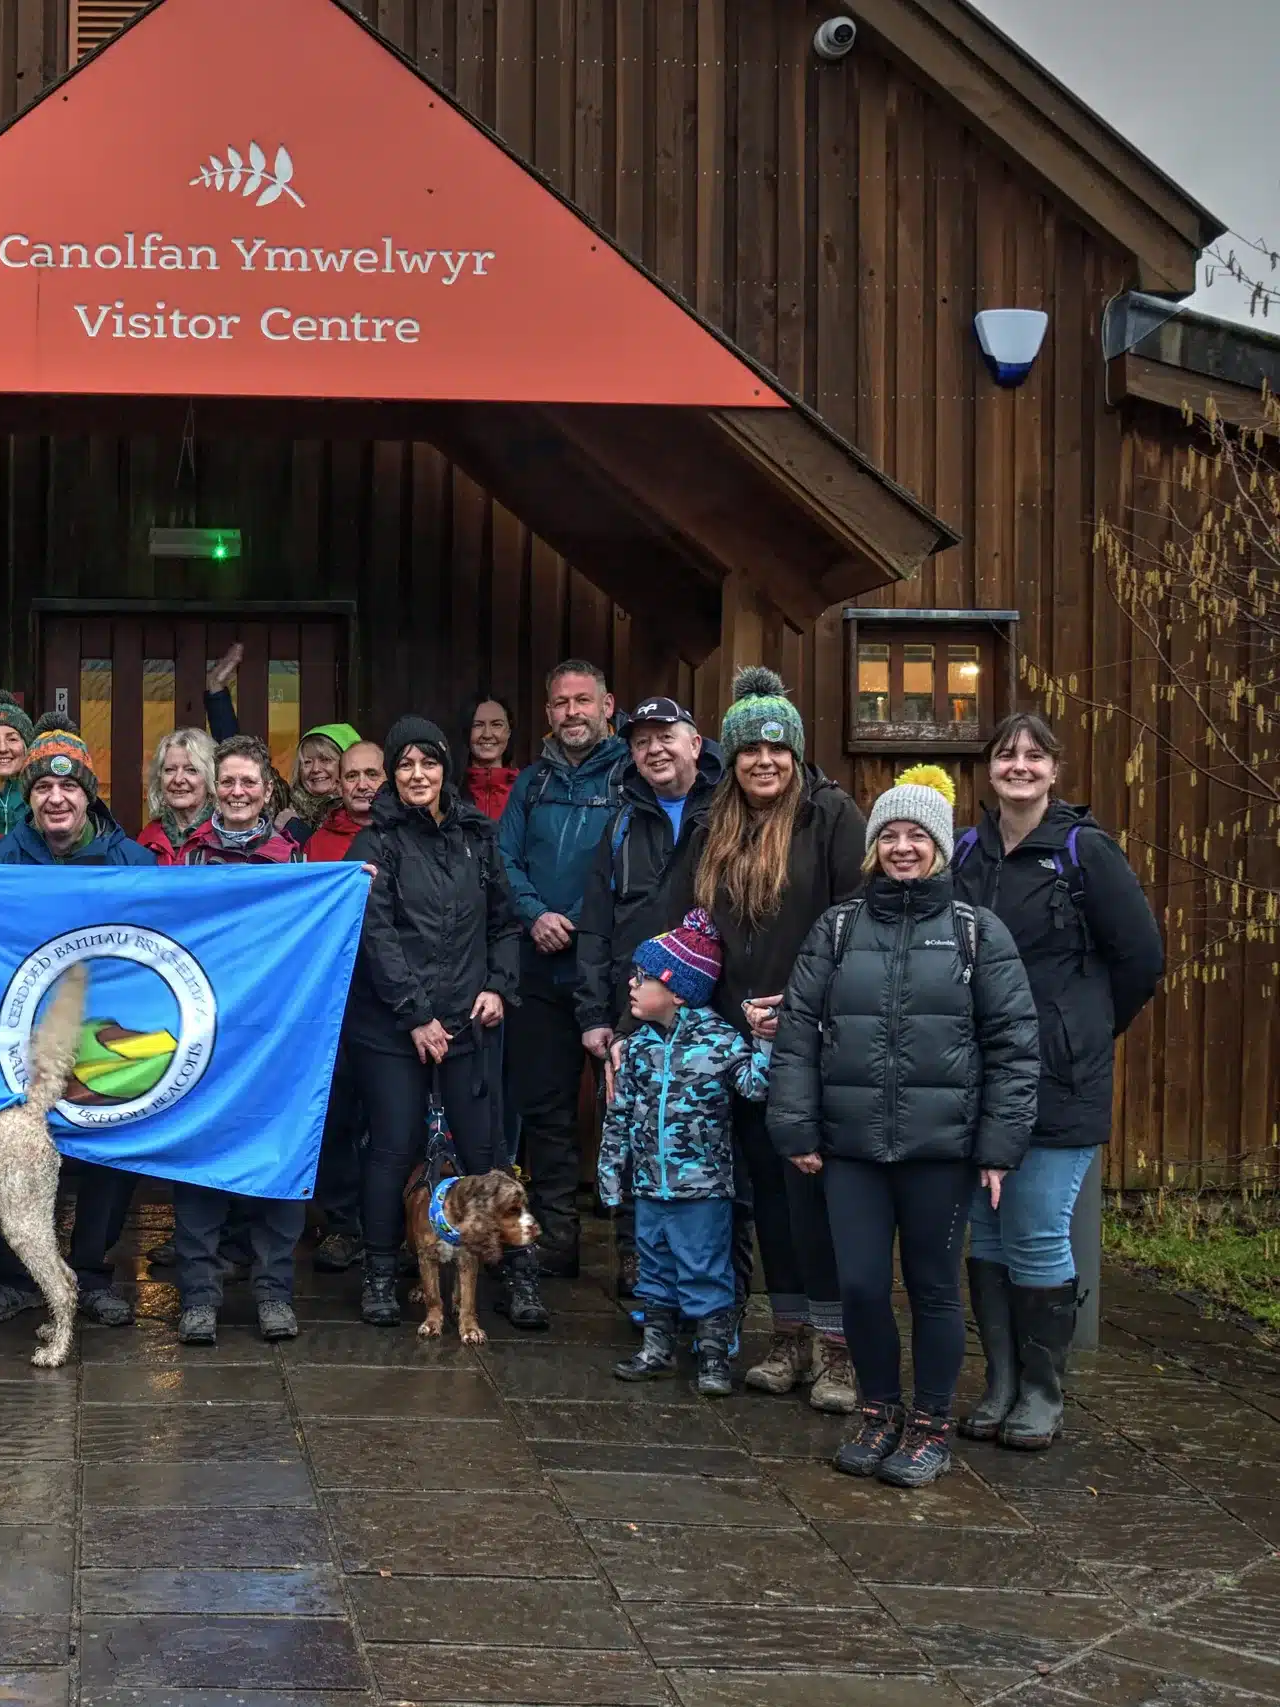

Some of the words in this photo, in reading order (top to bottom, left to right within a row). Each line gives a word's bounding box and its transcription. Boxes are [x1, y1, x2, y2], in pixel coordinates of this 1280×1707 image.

[231, 236, 495, 285] Ymwelwyr
[74, 299, 240, 341] Visitor
[260, 307, 421, 344] Centre
[6, 956, 52, 1029] CERDDED
[53, 932, 129, 959] BANNAU
[77, 1107, 149, 1124] BRECON
[151, 1041, 204, 1109] BEACONS
